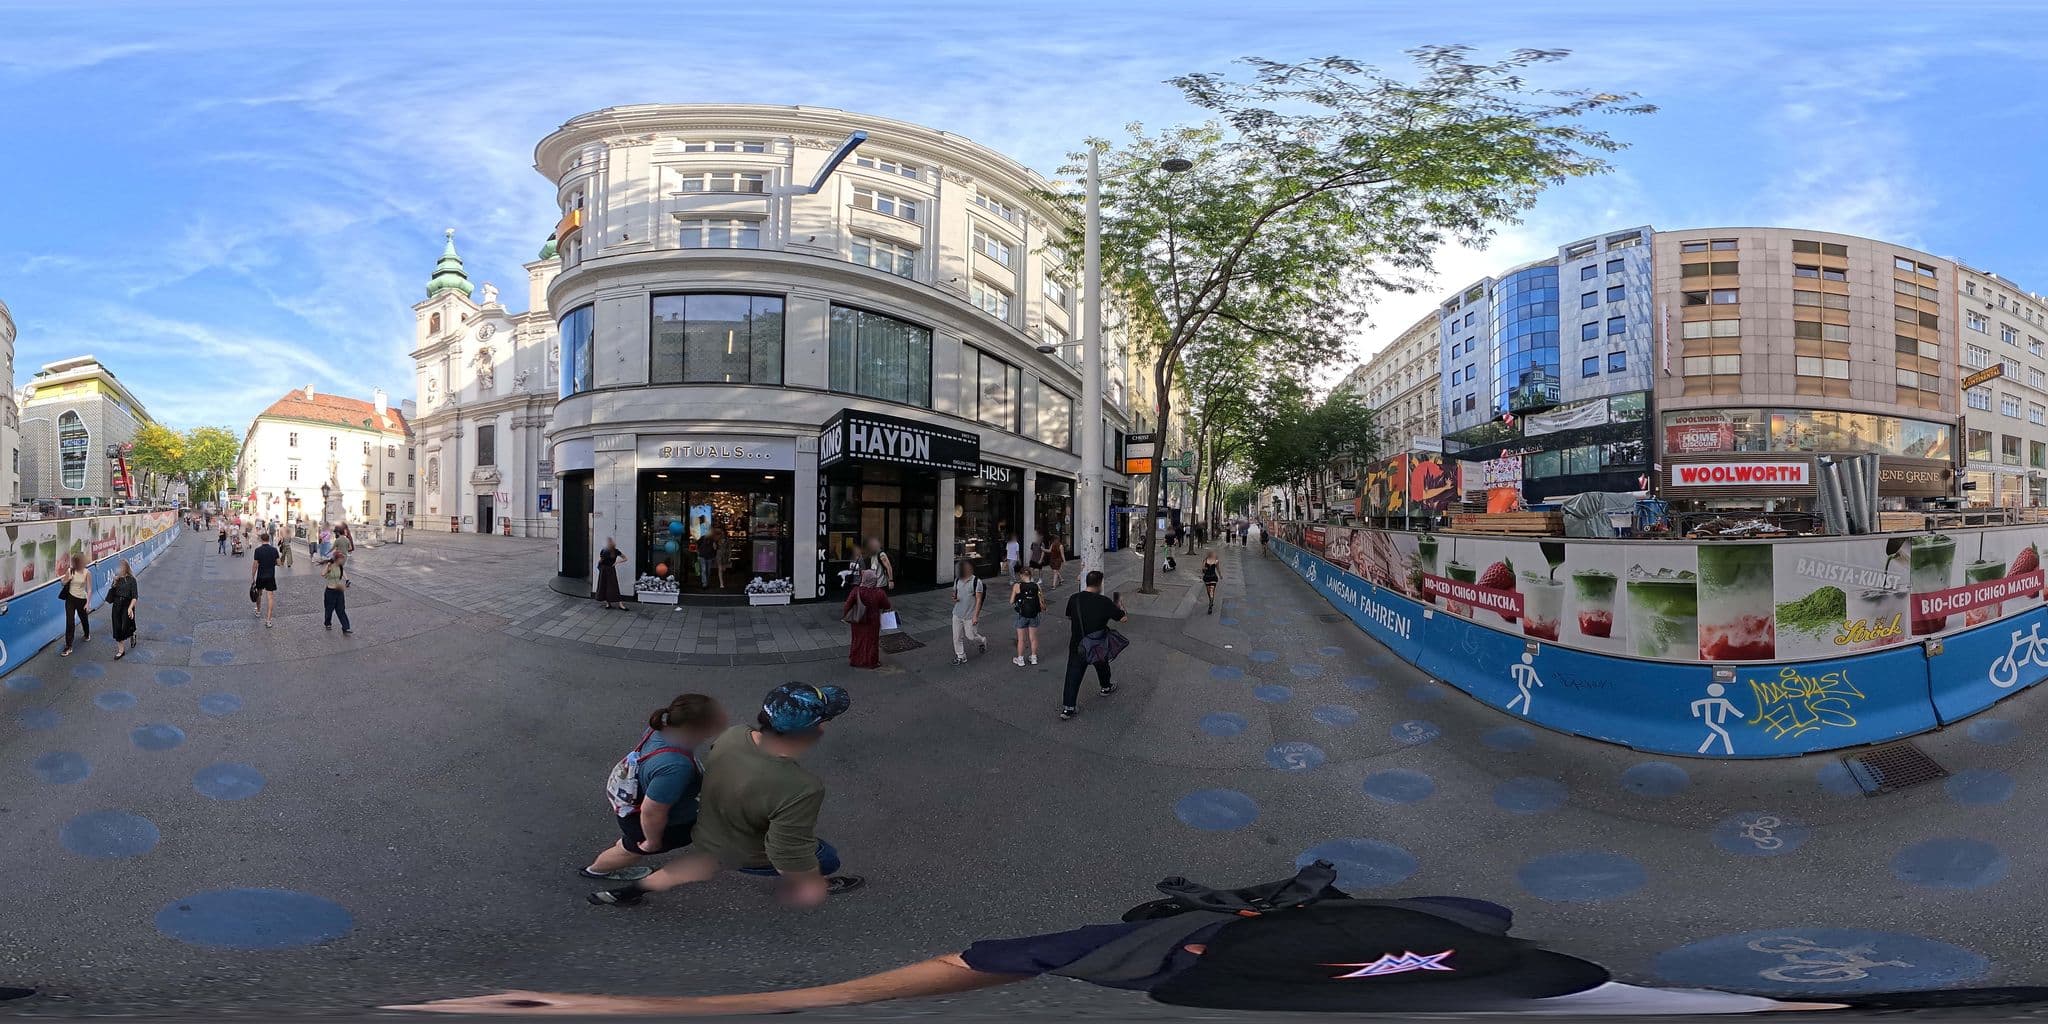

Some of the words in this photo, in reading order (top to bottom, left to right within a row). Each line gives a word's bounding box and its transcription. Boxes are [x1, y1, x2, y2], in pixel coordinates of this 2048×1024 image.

[820, 427, 842, 461] KINO
[850, 423, 930, 461] HAYDN
[1682, 433, 1718, 442] HOME
[1682, 440, 1718, 449] DISCOUNT
[1680, 466, 1801, 483] WOOLWORTH
[1905, 471, 1940, 483] GRENE
[818, 474, 828, 536] HAYDN
[818, 548, 826, 597] KINO
[1326, 574, 1357, 607] LANGSAM
[1360, 595, 1411, 640] FAHREN!
[1452, 584, 1477, 602] ICHIGO
[1478, 591, 1520, 613] MATCHA.
[1921, 591, 1972, 616] BIO-ICED
[1974, 584, 2006, 603] ICHIGO
[2008, 575, 2042, 595] MATCHA.
